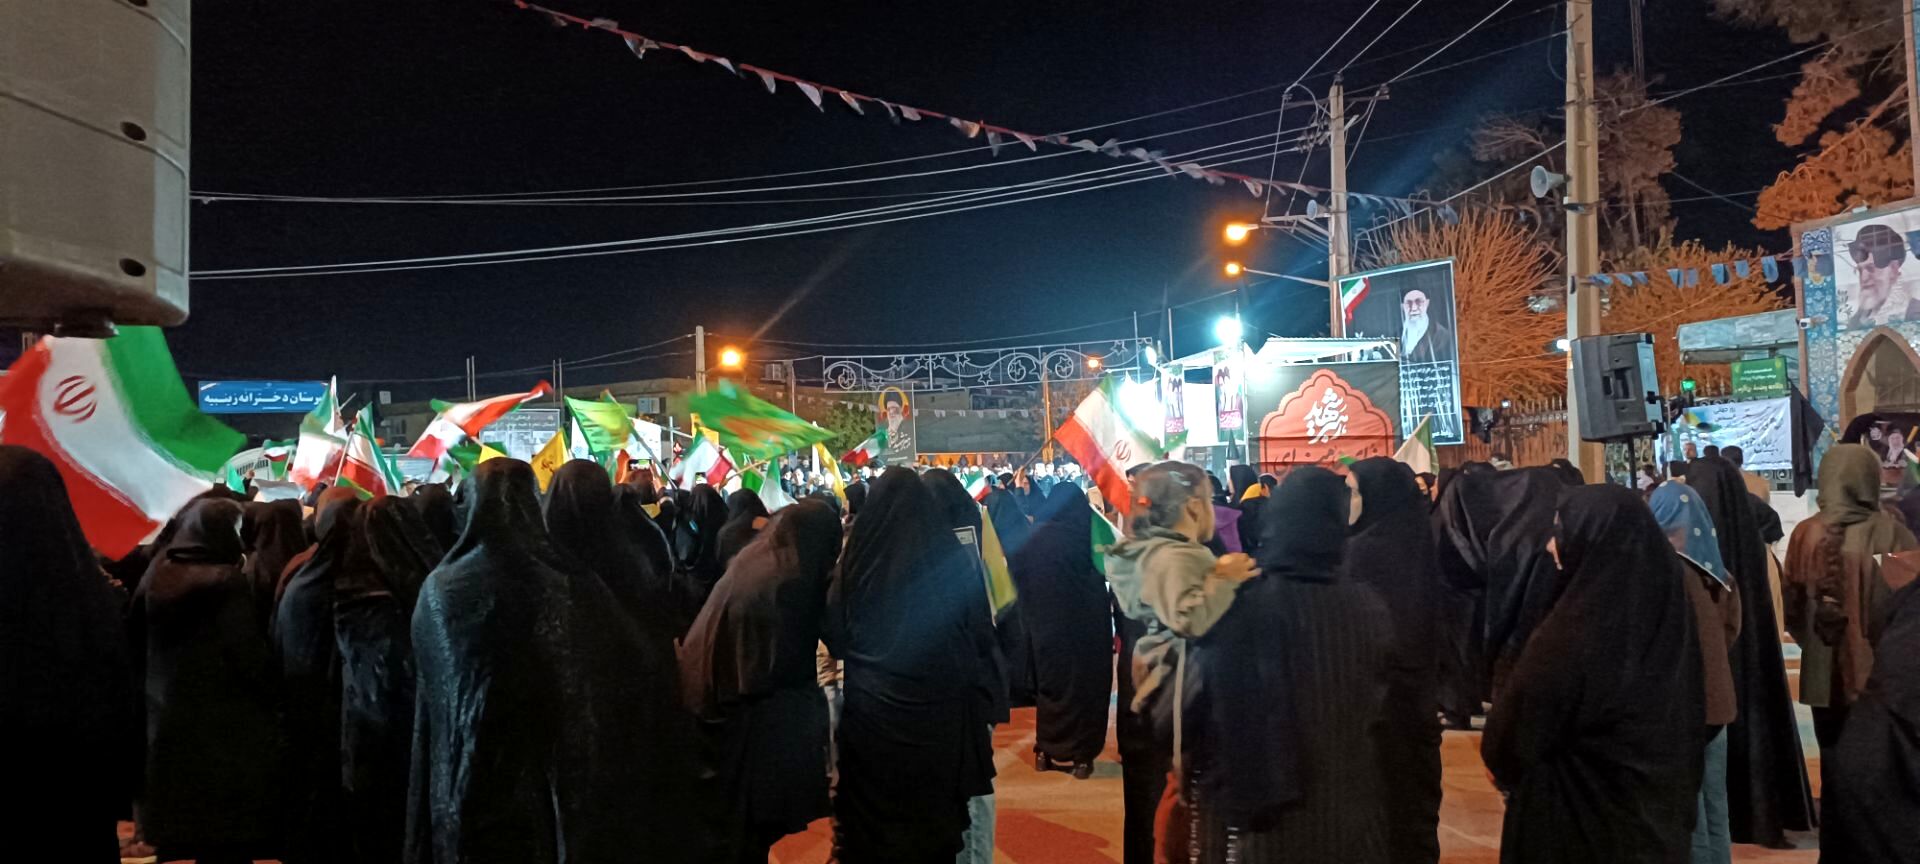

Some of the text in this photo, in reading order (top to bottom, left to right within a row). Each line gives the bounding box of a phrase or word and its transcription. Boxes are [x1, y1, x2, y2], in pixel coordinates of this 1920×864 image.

[204, 391, 323, 407] رستان دخترانه زینبیه
